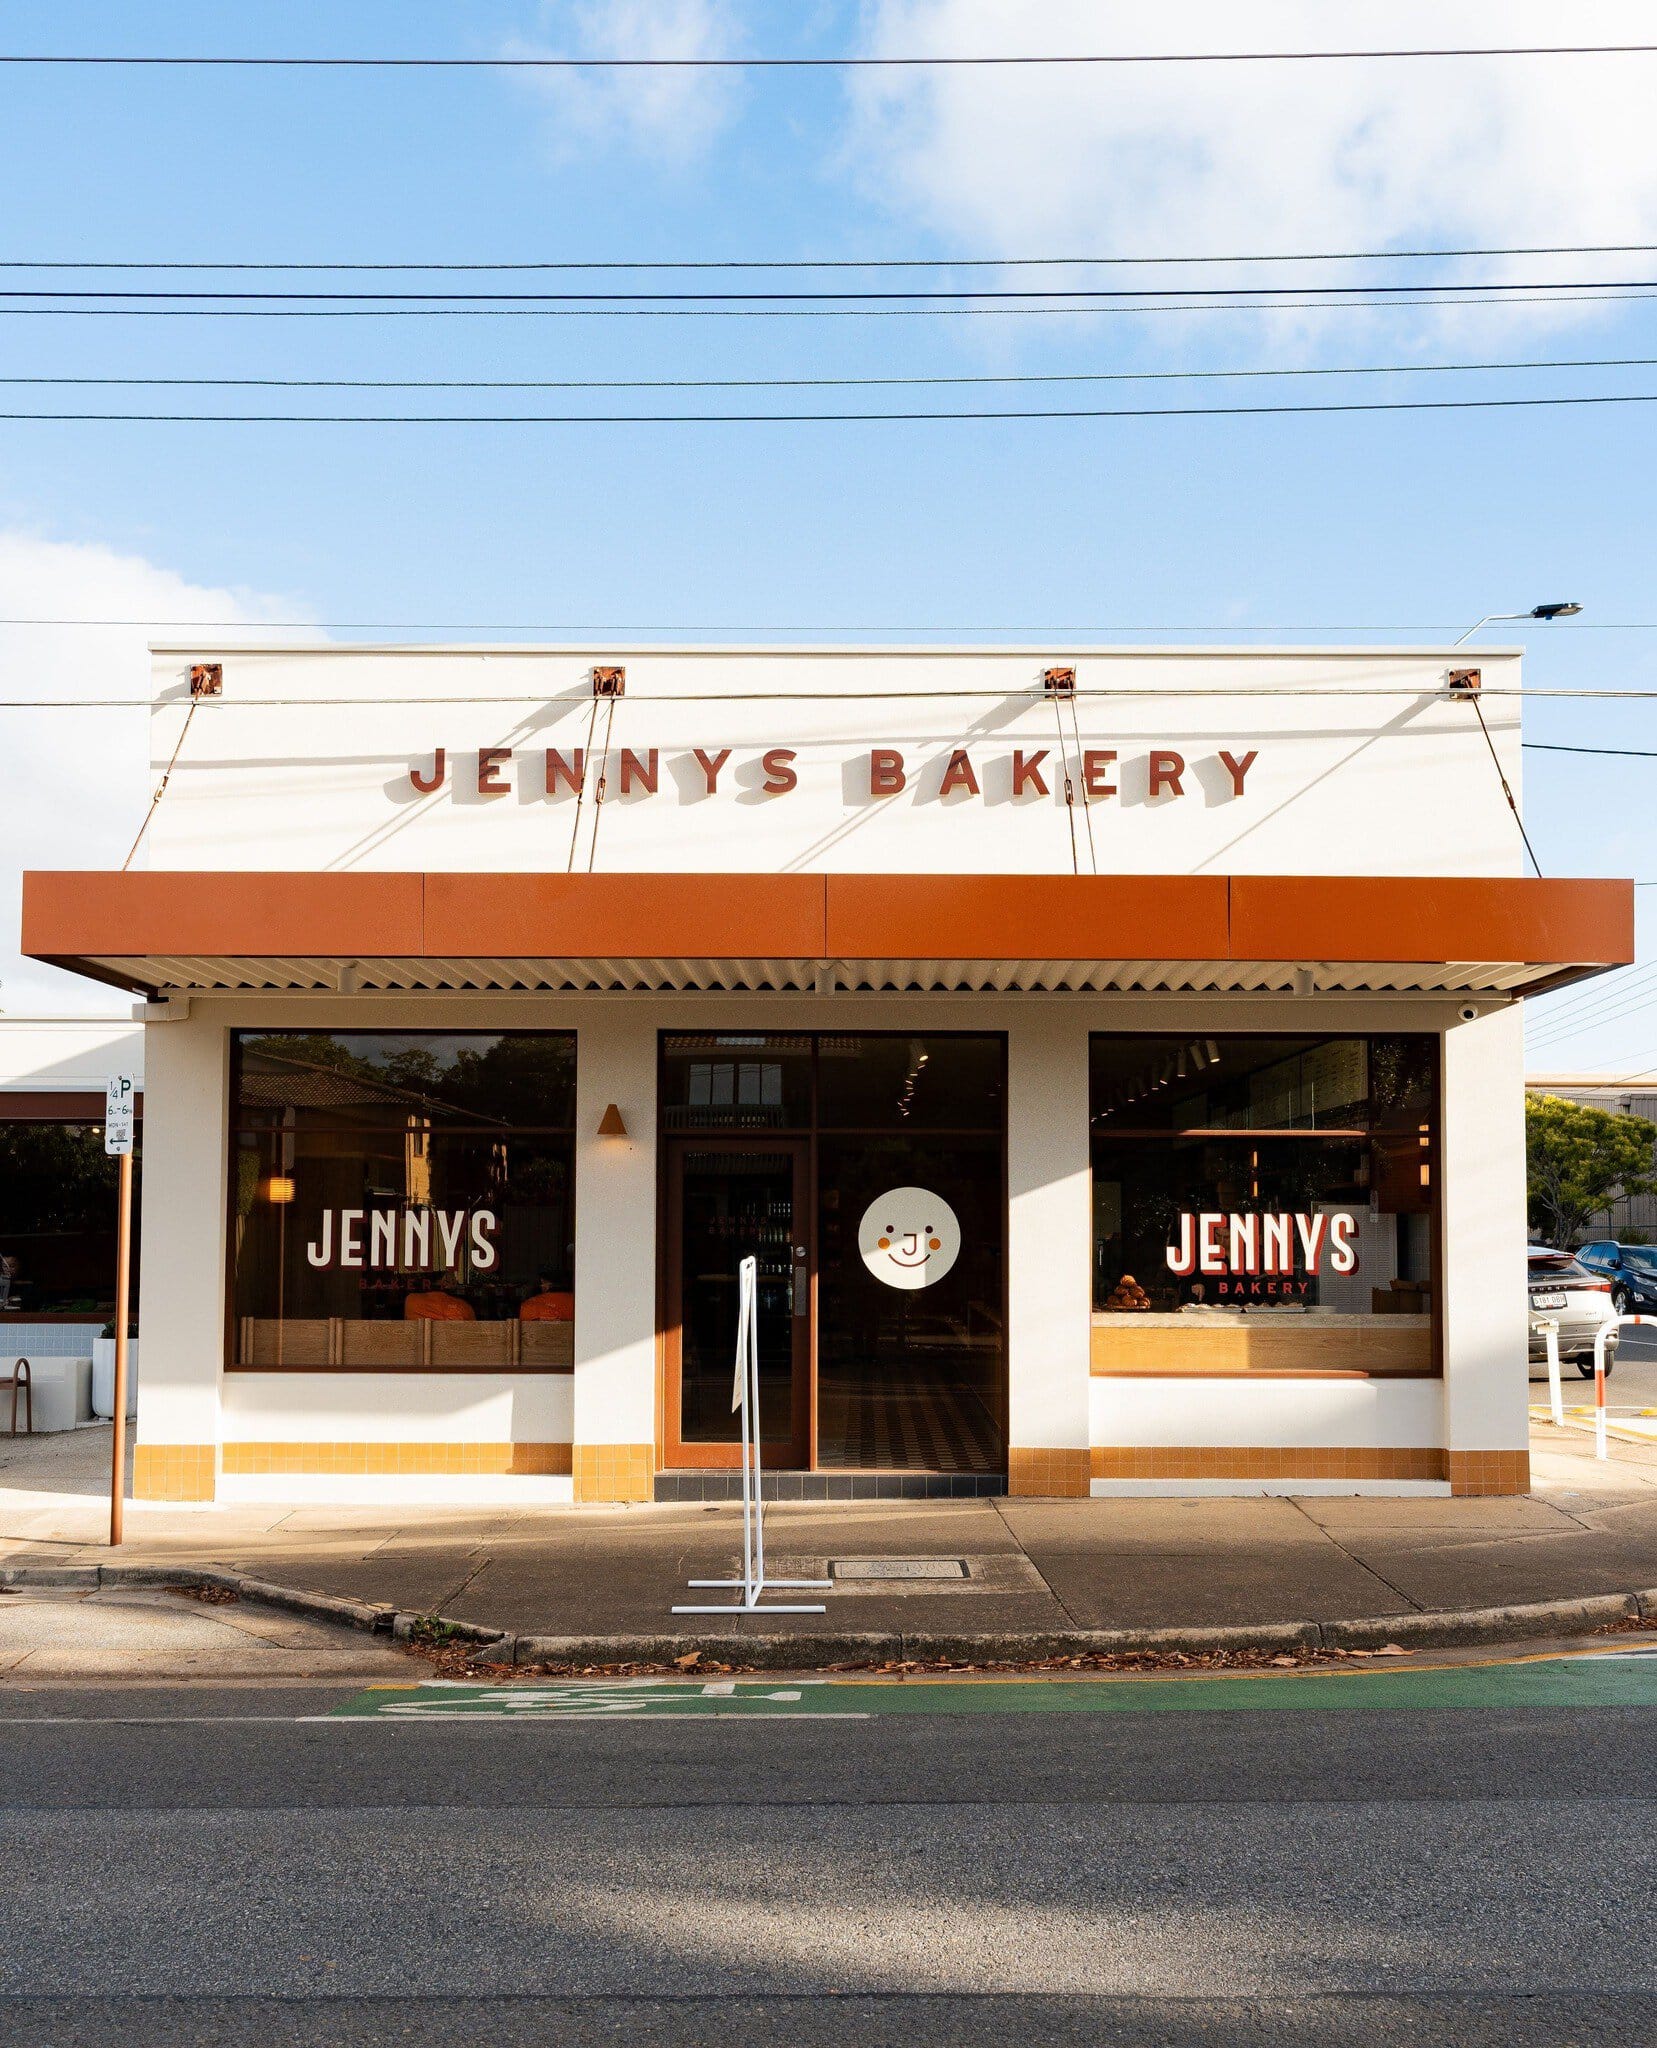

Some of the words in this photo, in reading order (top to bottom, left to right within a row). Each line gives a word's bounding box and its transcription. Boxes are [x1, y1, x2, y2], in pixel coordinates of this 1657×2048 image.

[409, 748, 798, 794] JENNYS
[870, 749, 1259, 797] BAKERY
[307, 1209, 500, 1271] JENNYS
[1166, 1212, 1360, 1276] JENNYS
[1218, 1281, 1310, 1294] BAKERY
